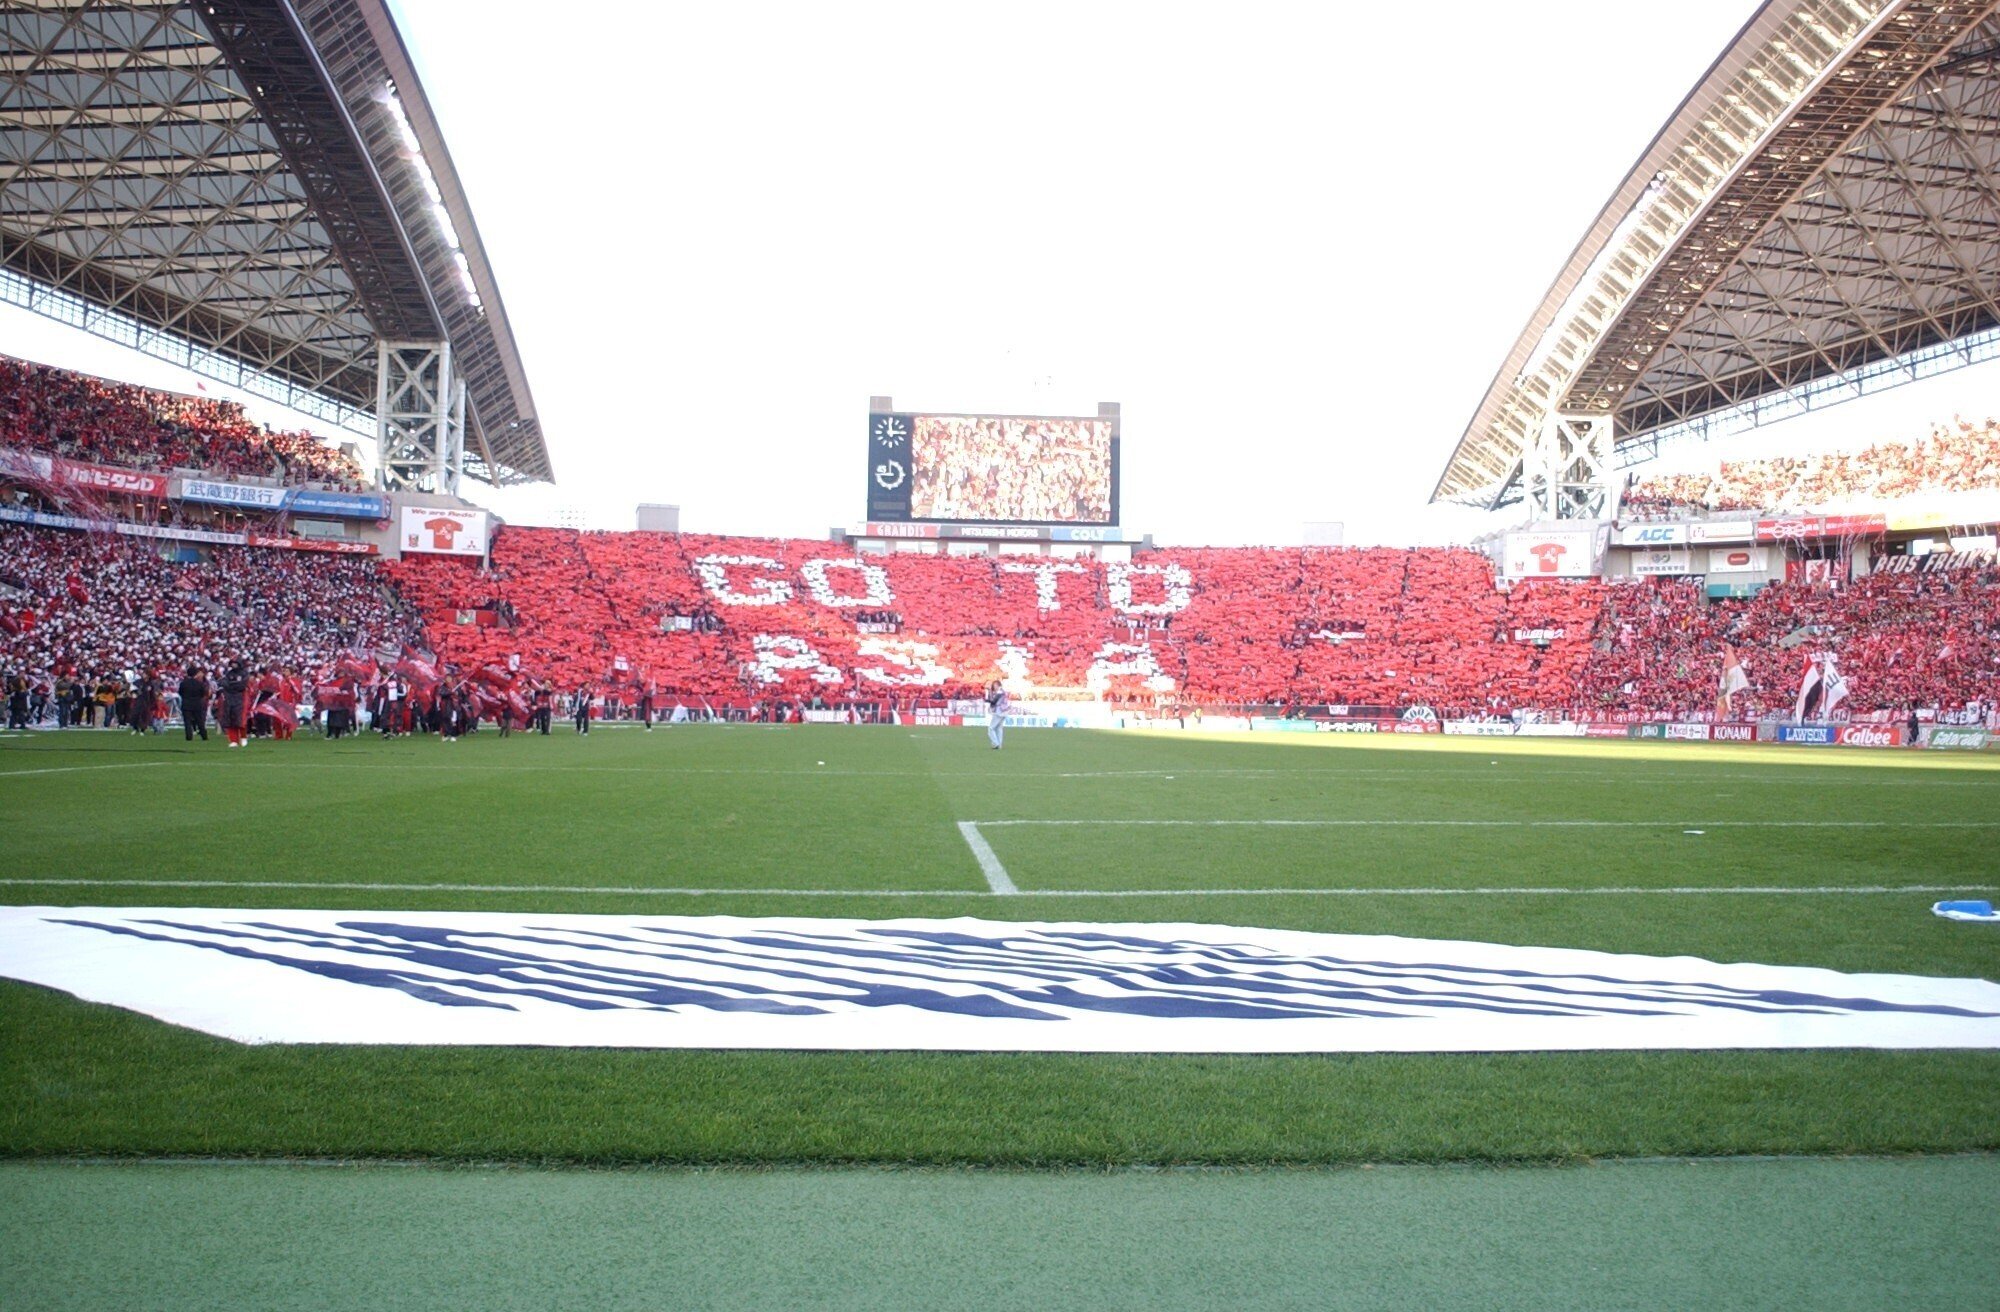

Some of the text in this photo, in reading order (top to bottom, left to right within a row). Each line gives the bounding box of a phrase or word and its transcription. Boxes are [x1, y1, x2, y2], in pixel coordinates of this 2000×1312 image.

[188, 483, 274, 504] 武蔵野銀行
[876, 523, 926, 537] GRANDIS
[961, 527, 1039, 538] MITSUBISHI MOTORS
[1070, 528, 1106, 541] COLT
[1635, 528, 1675, 542] AGC
[1872, 553, 1922, 574] REDS
[693, 554, 1194, 614] GO TO
[749, 634, 1177, 696] ASIA
[915, 716, 950, 726] KIRIN
[1714, 726, 1752, 740] KONAMI
[1785, 728, 1828, 742] LAWSON
[1843, 727, 1892, 745] Calbee
[1931, 731, 1985, 747] Gatorade
